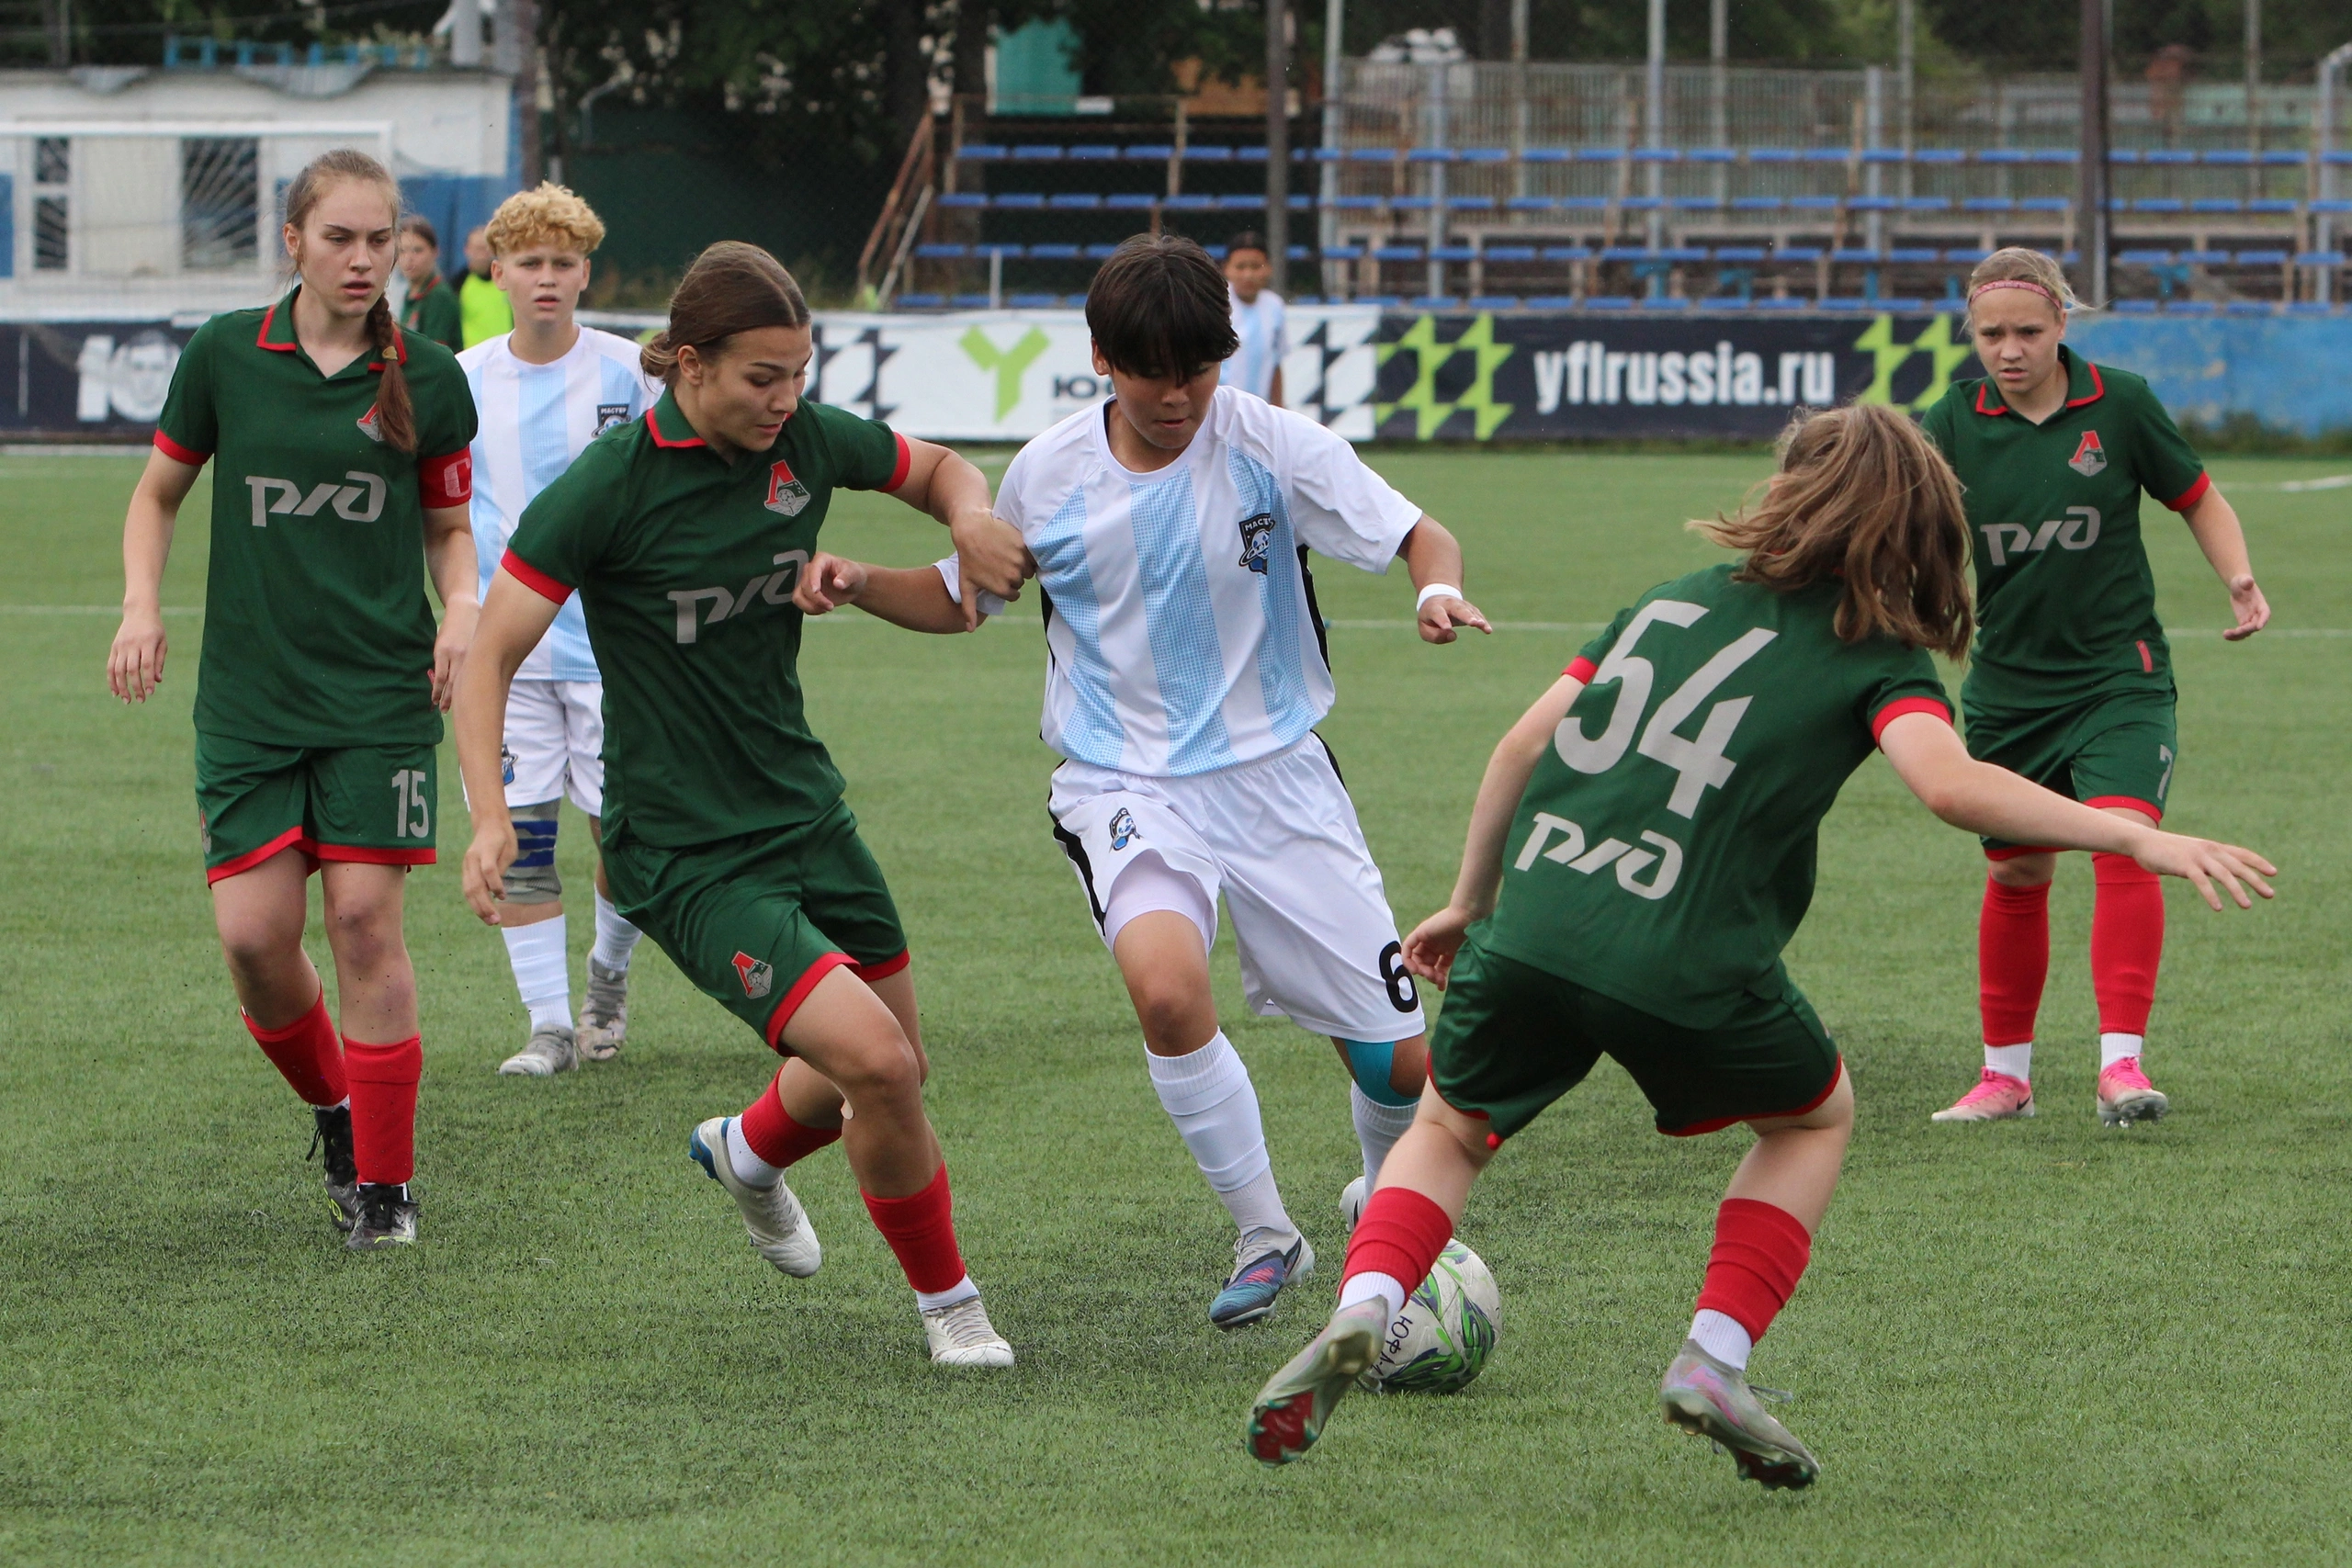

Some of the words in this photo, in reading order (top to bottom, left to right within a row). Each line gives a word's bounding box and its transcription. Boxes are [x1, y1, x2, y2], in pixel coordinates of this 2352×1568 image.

[1533, 340, 1835, 414] yflrussia.ru
[1555, 599, 1779, 819] 54
[391, 769, 429, 839] 15
[1379, 941, 1419, 1013] 6
